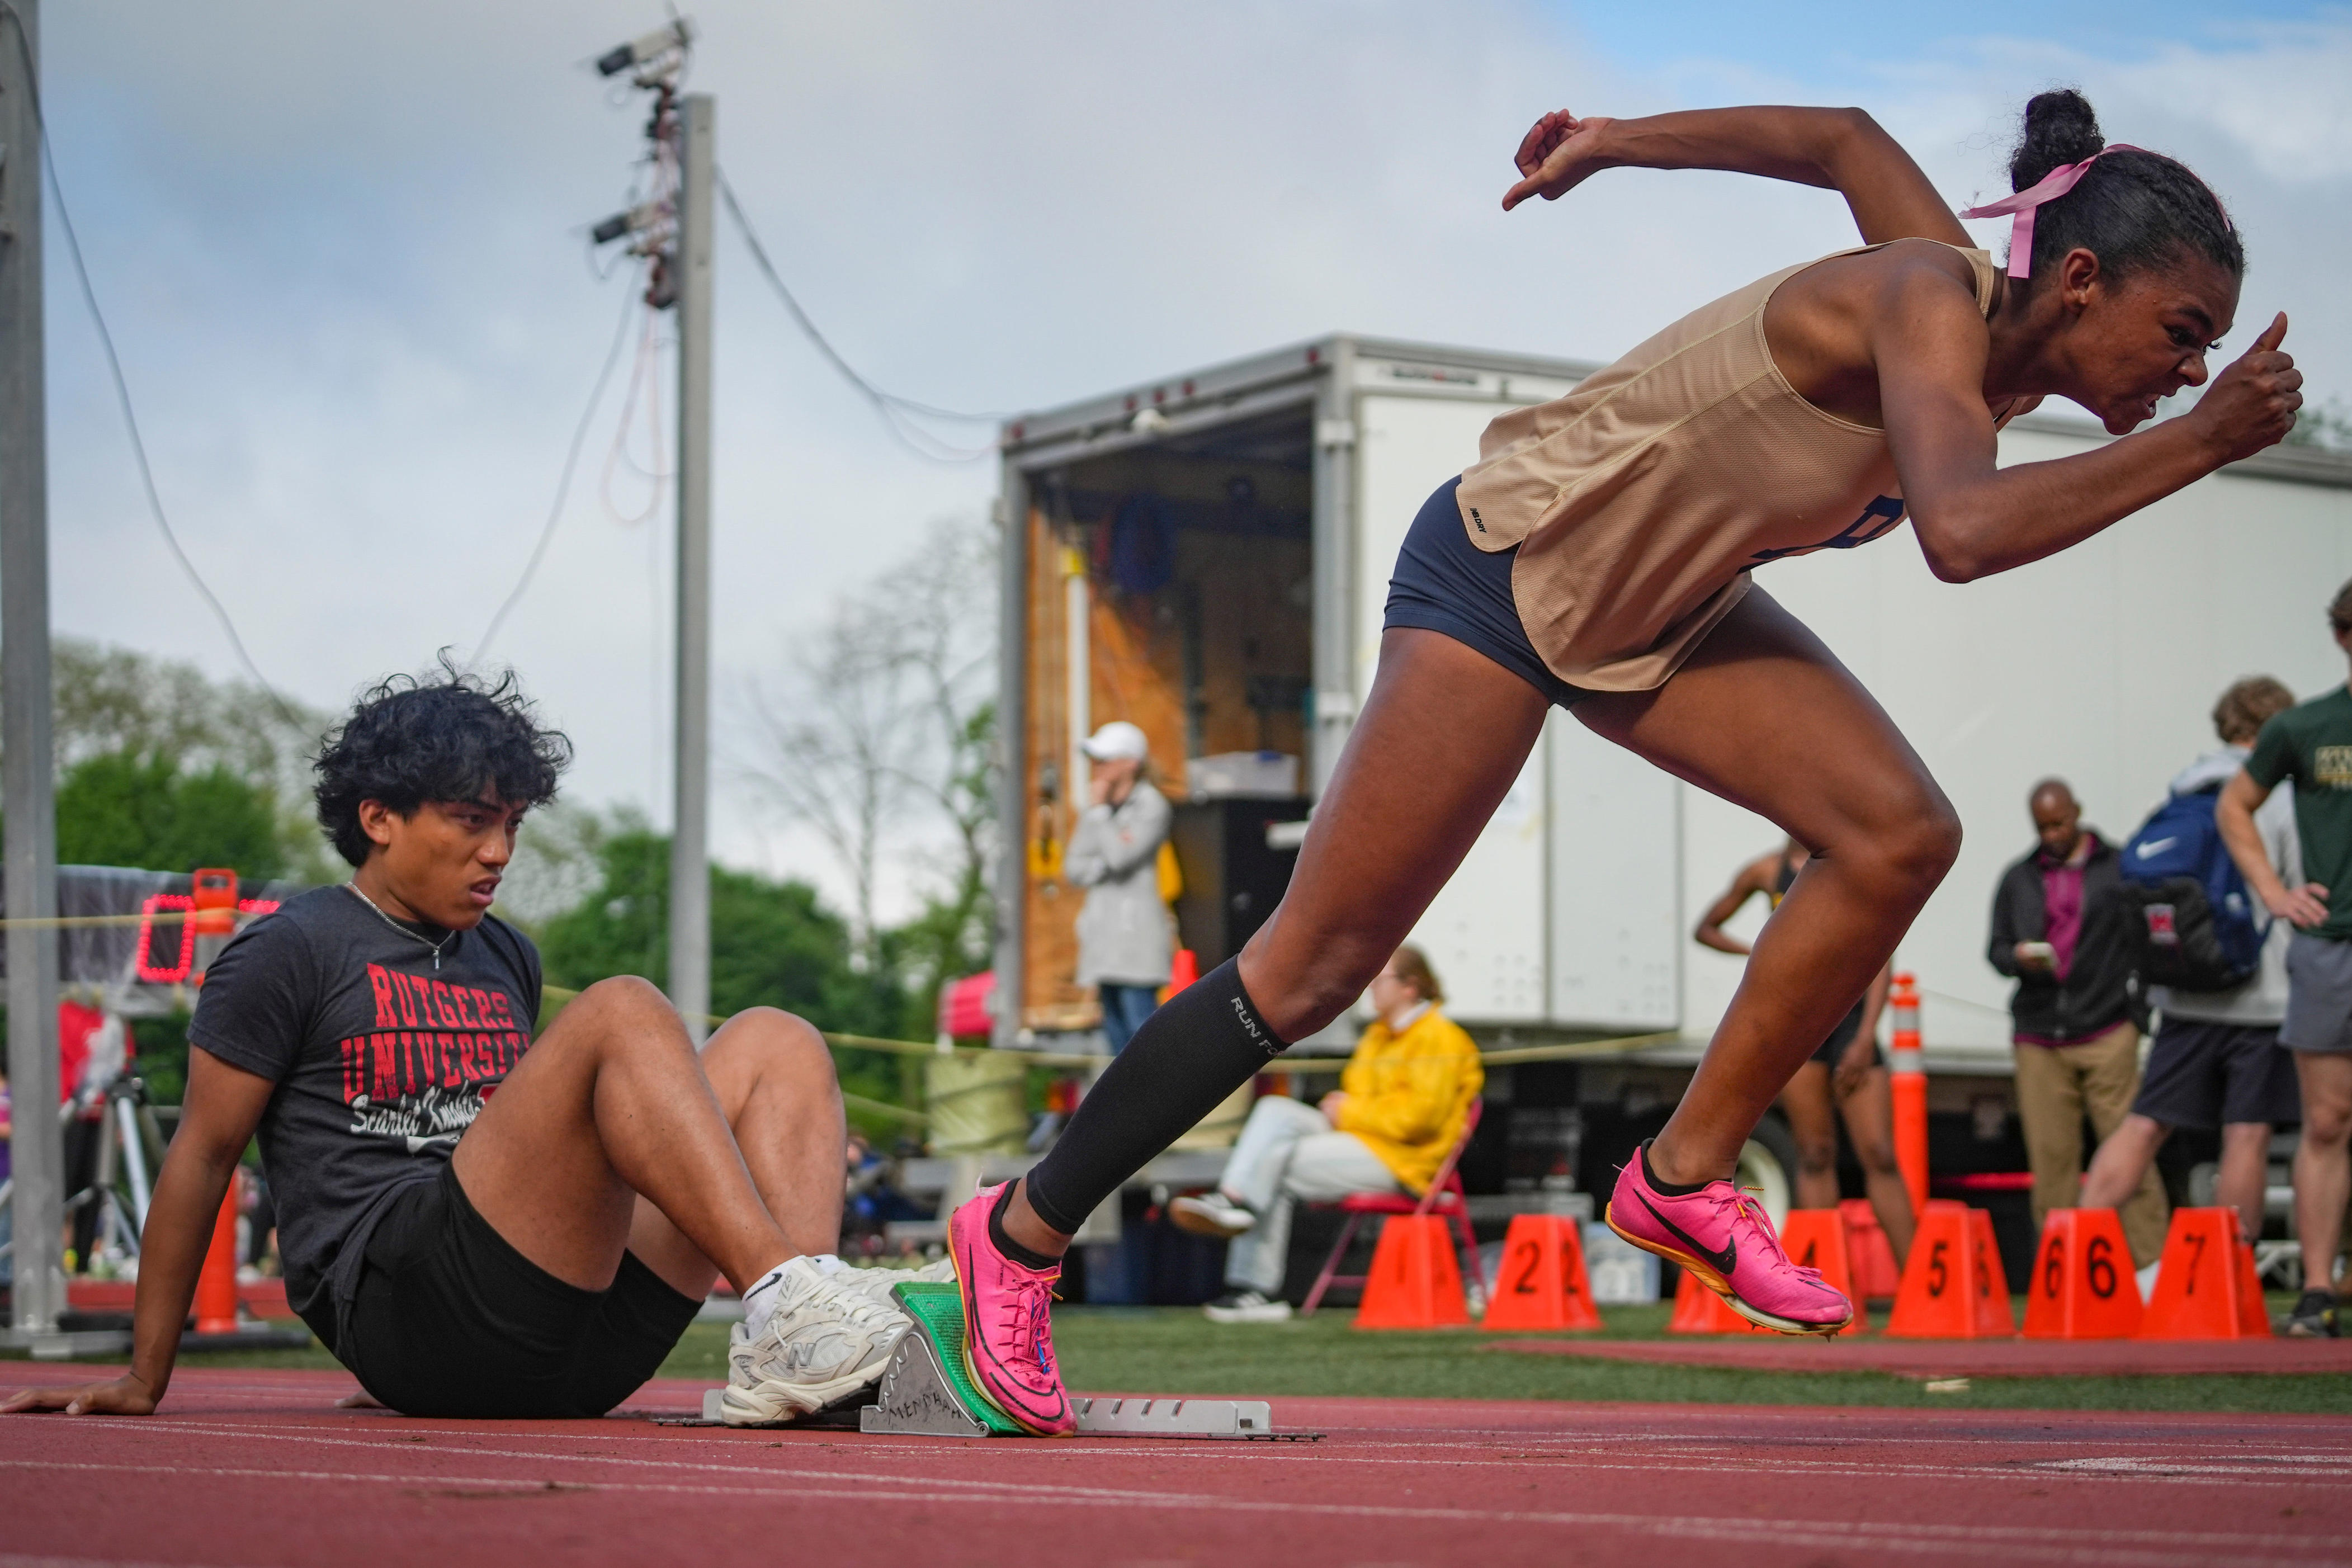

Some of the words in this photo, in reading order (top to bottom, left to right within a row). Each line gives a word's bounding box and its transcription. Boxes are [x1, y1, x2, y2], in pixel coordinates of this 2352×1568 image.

[1475, 518, 1487, 533] DRY
[367, 962, 514, 1028] RUTGERS
[1231, 996, 1261, 1038] RUN
[778, 1273, 792, 1299] 725
[1516, 1241, 1539, 1294] 2
[1929, 1240, 1947, 1298] 5
[2045, 1236, 2063, 1299] 6
[2087, 1236, 2117, 1298] 6
[2185, 1233, 2205, 1295] 7
